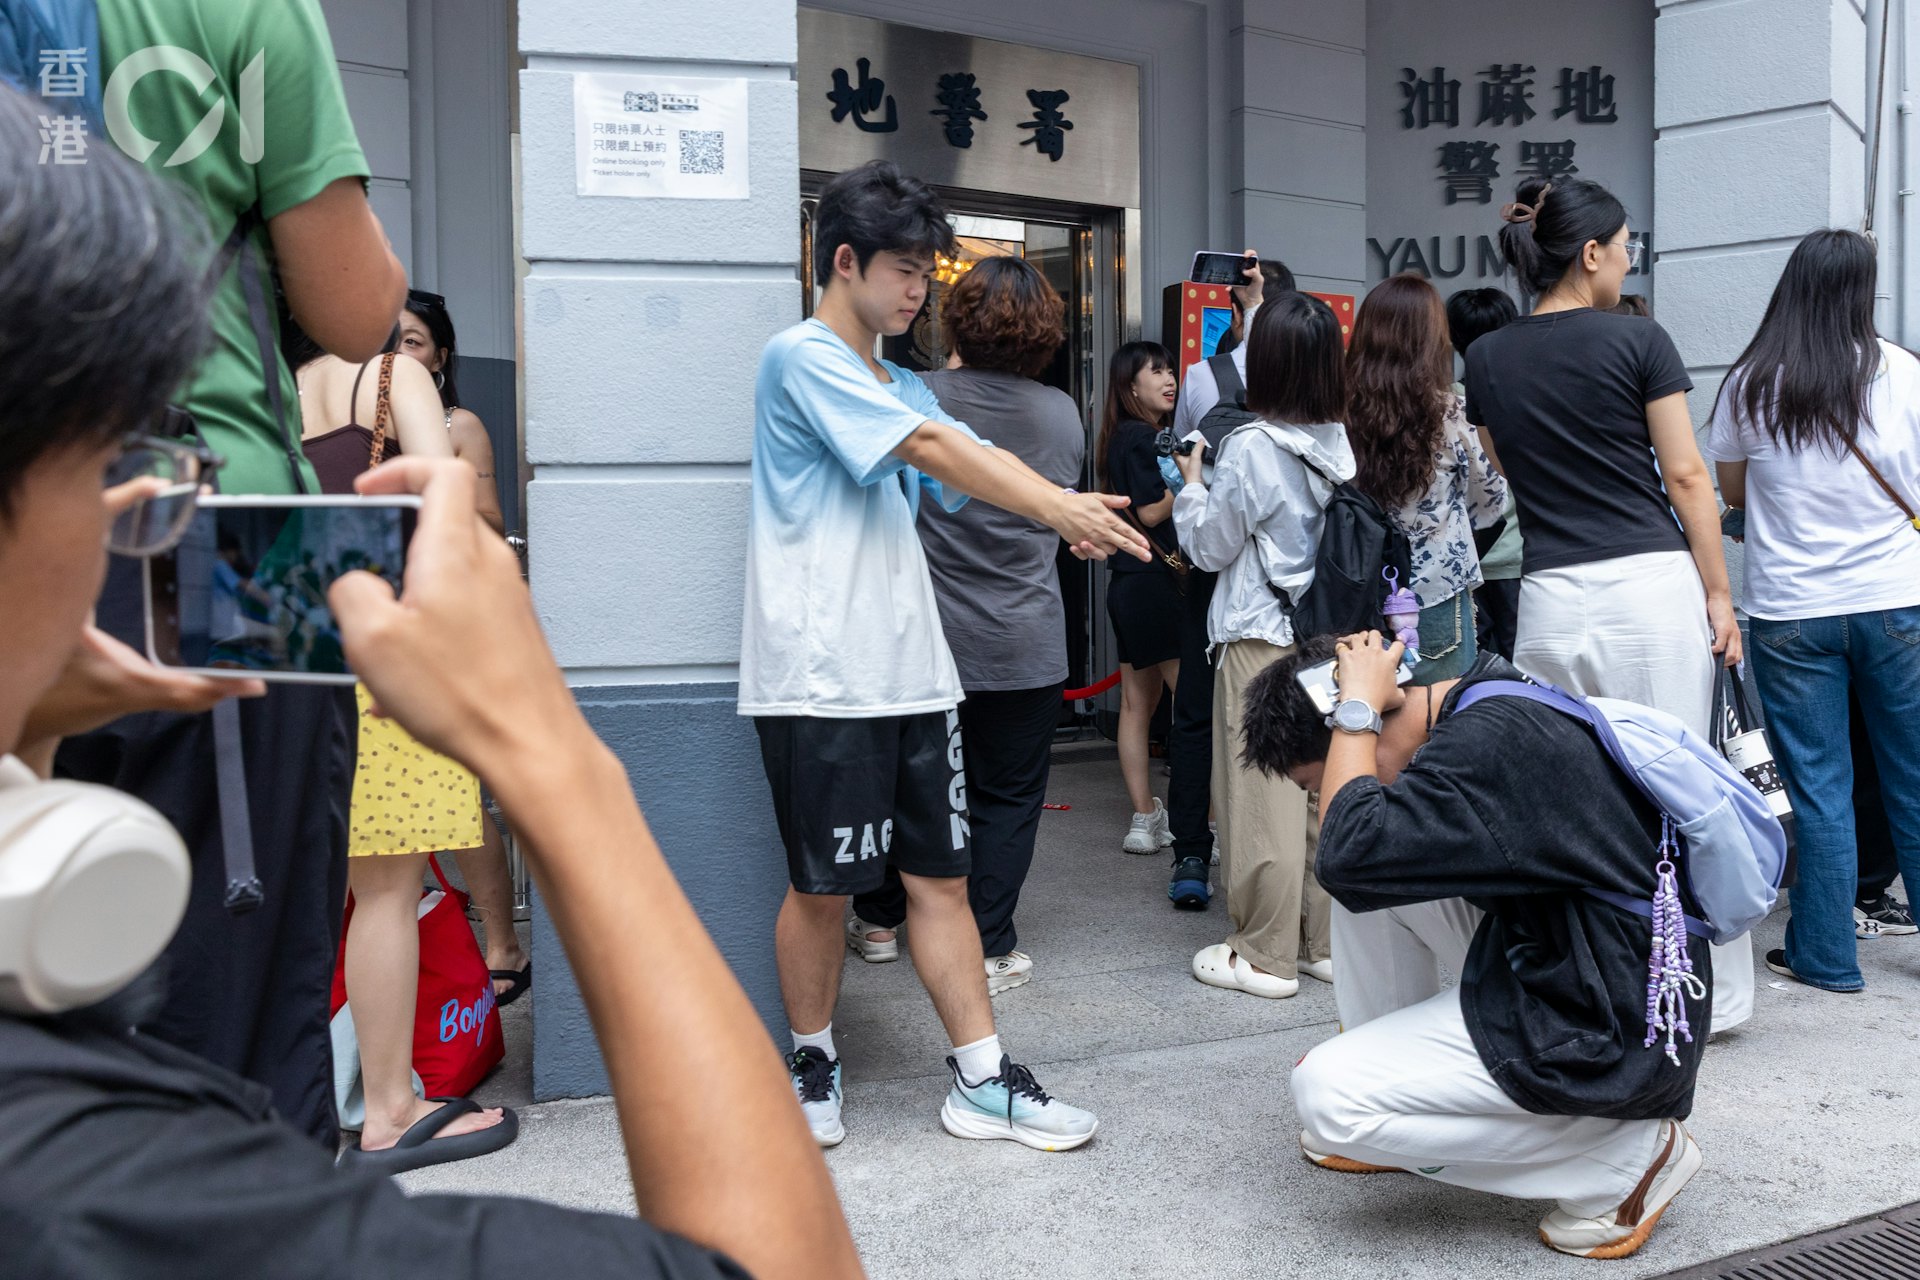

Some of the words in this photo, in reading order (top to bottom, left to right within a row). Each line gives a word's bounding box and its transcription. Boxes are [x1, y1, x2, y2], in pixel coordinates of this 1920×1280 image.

[826, 57, 1073, 161] 地警署
[593, 123, 666, 136] 只限持票人士
[593, 139, 667, 152] 只限網上預約
[593, 157, 617, 165] Online
[618, 158, 649, 167] booking
[650, 159, 665, 167] only
[1366, 235, 1465, 279] YAU
